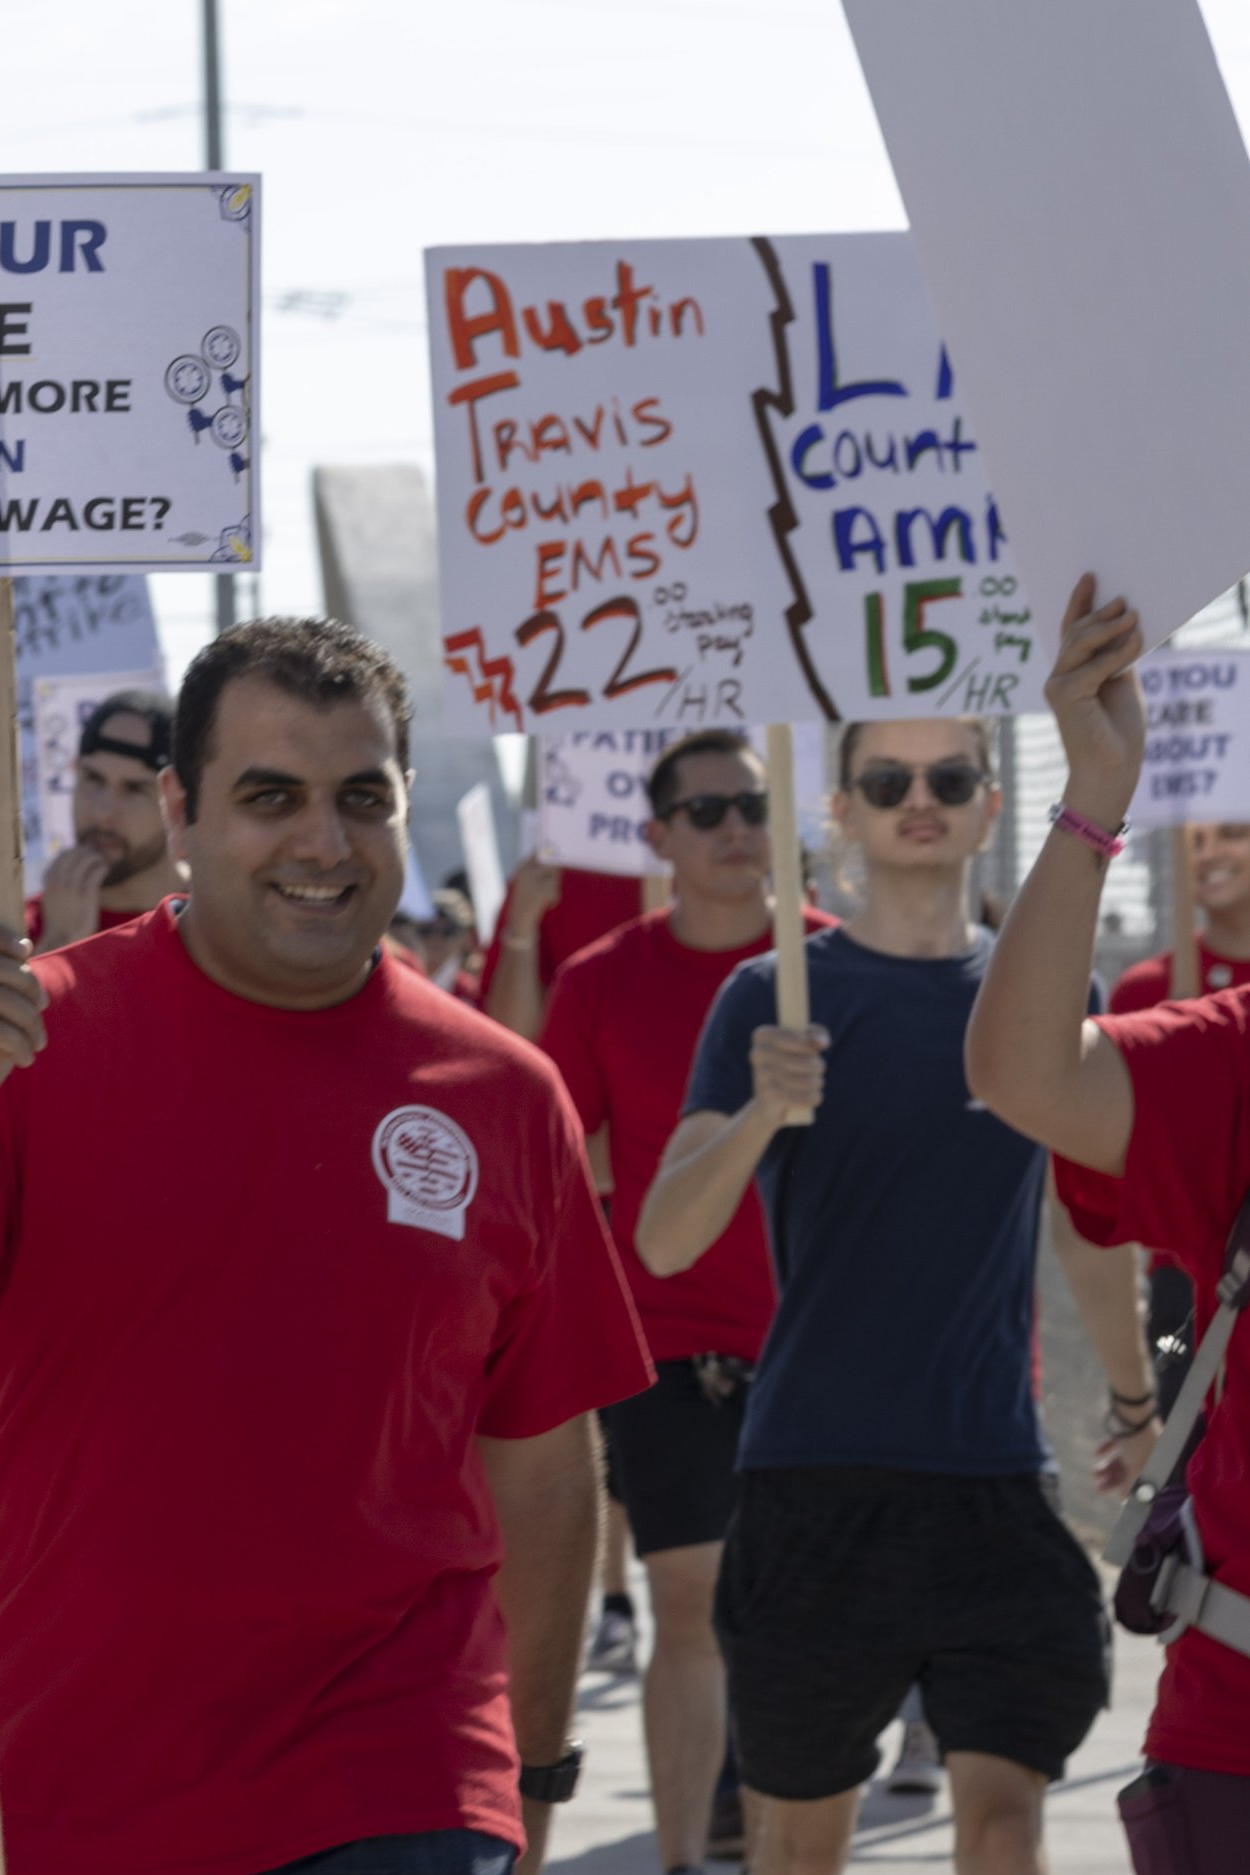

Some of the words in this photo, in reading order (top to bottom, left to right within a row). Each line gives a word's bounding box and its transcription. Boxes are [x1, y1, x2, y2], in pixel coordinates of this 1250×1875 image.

[444, 259, 704, 370] Austin
[532, 533, 662, 610] EMS
[514, 595, 678, 715] 22
[863, 576, 964, 700] 15
